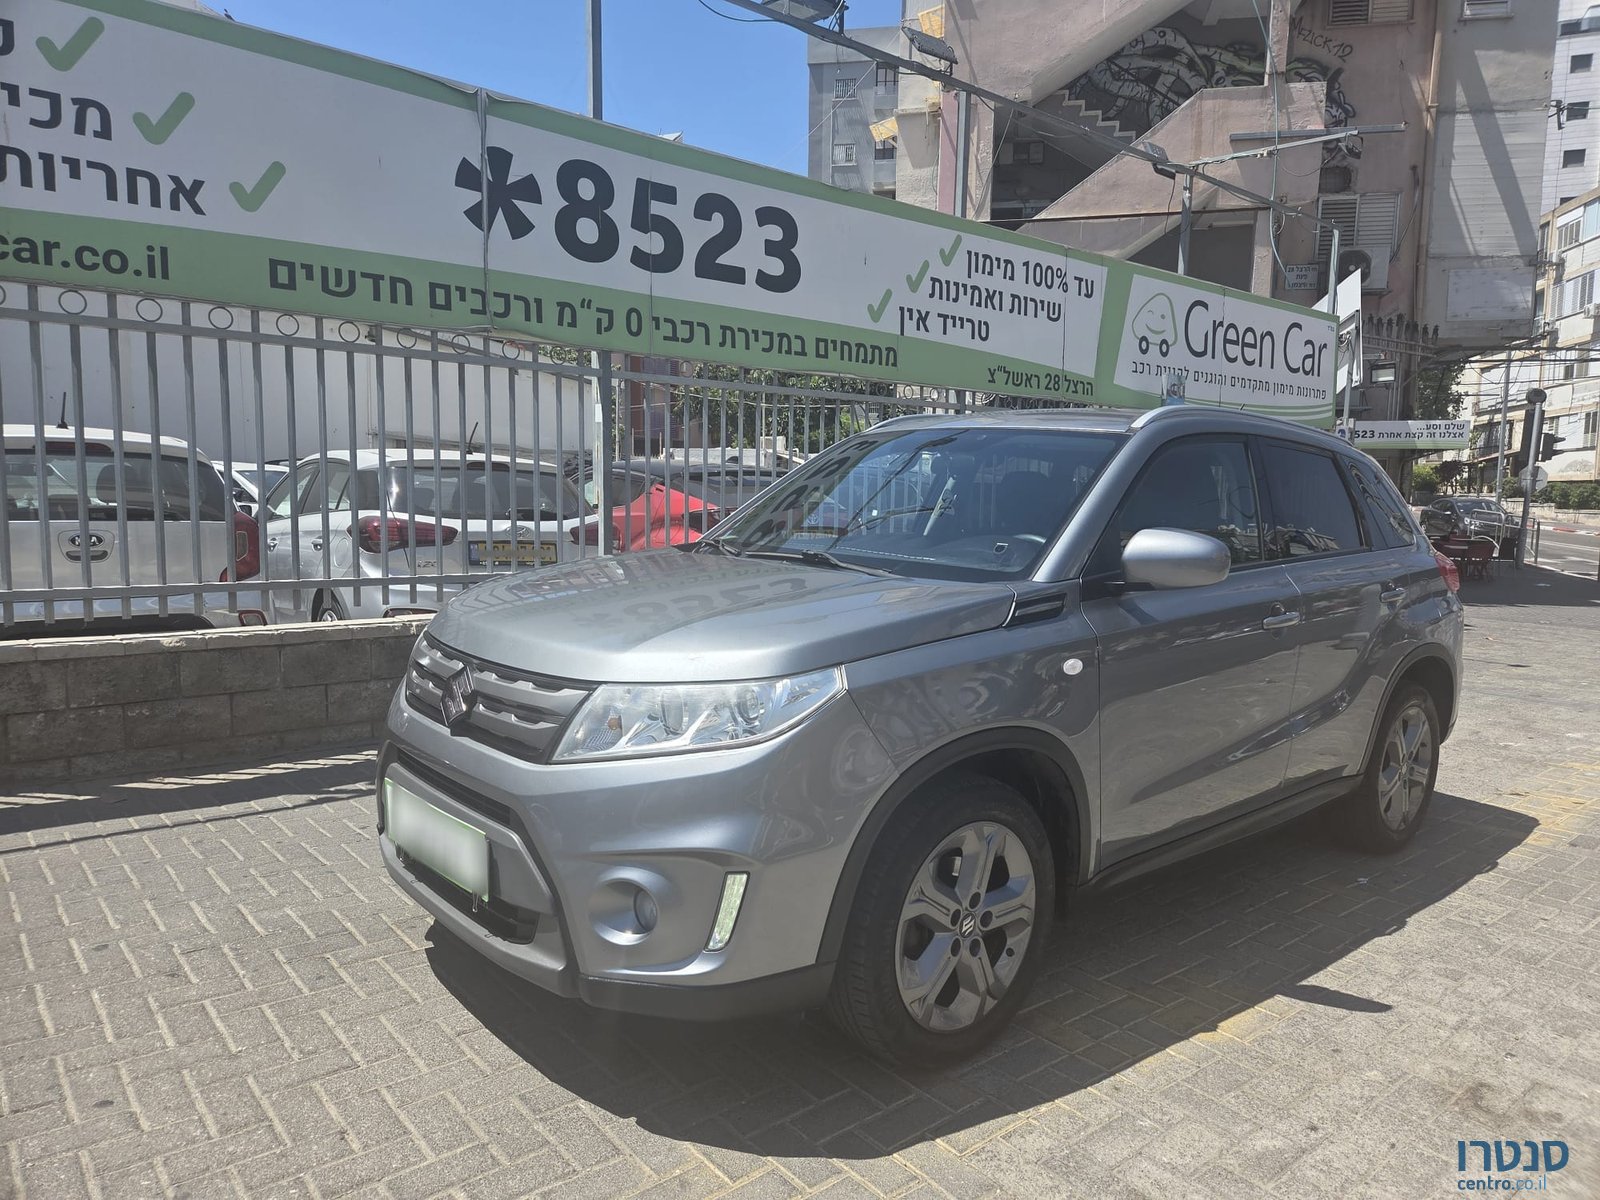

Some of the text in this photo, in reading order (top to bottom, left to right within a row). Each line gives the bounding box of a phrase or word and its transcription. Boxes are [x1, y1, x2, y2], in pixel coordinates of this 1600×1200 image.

[0, 145, 206, 216] אחריות
[268, 258, 413, 306] חדשים
[966, 249, 1095, 299] עד 100% מימון
[428, 281, 543, 324] ורכבים
[928, 276, 1062, 322] שירות ואמינות
[651, 315, 711, 346] רכבי
[898, 306, 990, 342] טרייד אין
[718, 324, 808, 357] במכירת
[1184, 299, 1328, 377] Green Car
[815, 337, 898, 367] מתמחים
[1131, 361, 1151, 376] רכב
[1193, 369, 1227, 386] והוגנים
[1044, 373, 1061, 392] 28
[1063, 375, 1094, 396] הרצל
[1230, 376, 1270, 393] מתקדמים
[1272, 382, 1294, 396] מימון
[1296, 385, 1327, 400] פתרונות
[1378, 431, 1402, 439] אחרת
[1404, 431, 1423, 440] קצת
[1426, 431, 1436, 439] זה
[1439, 430, 1465, 439] אצלנו
[1444, 422, 1465, 431] שלם
